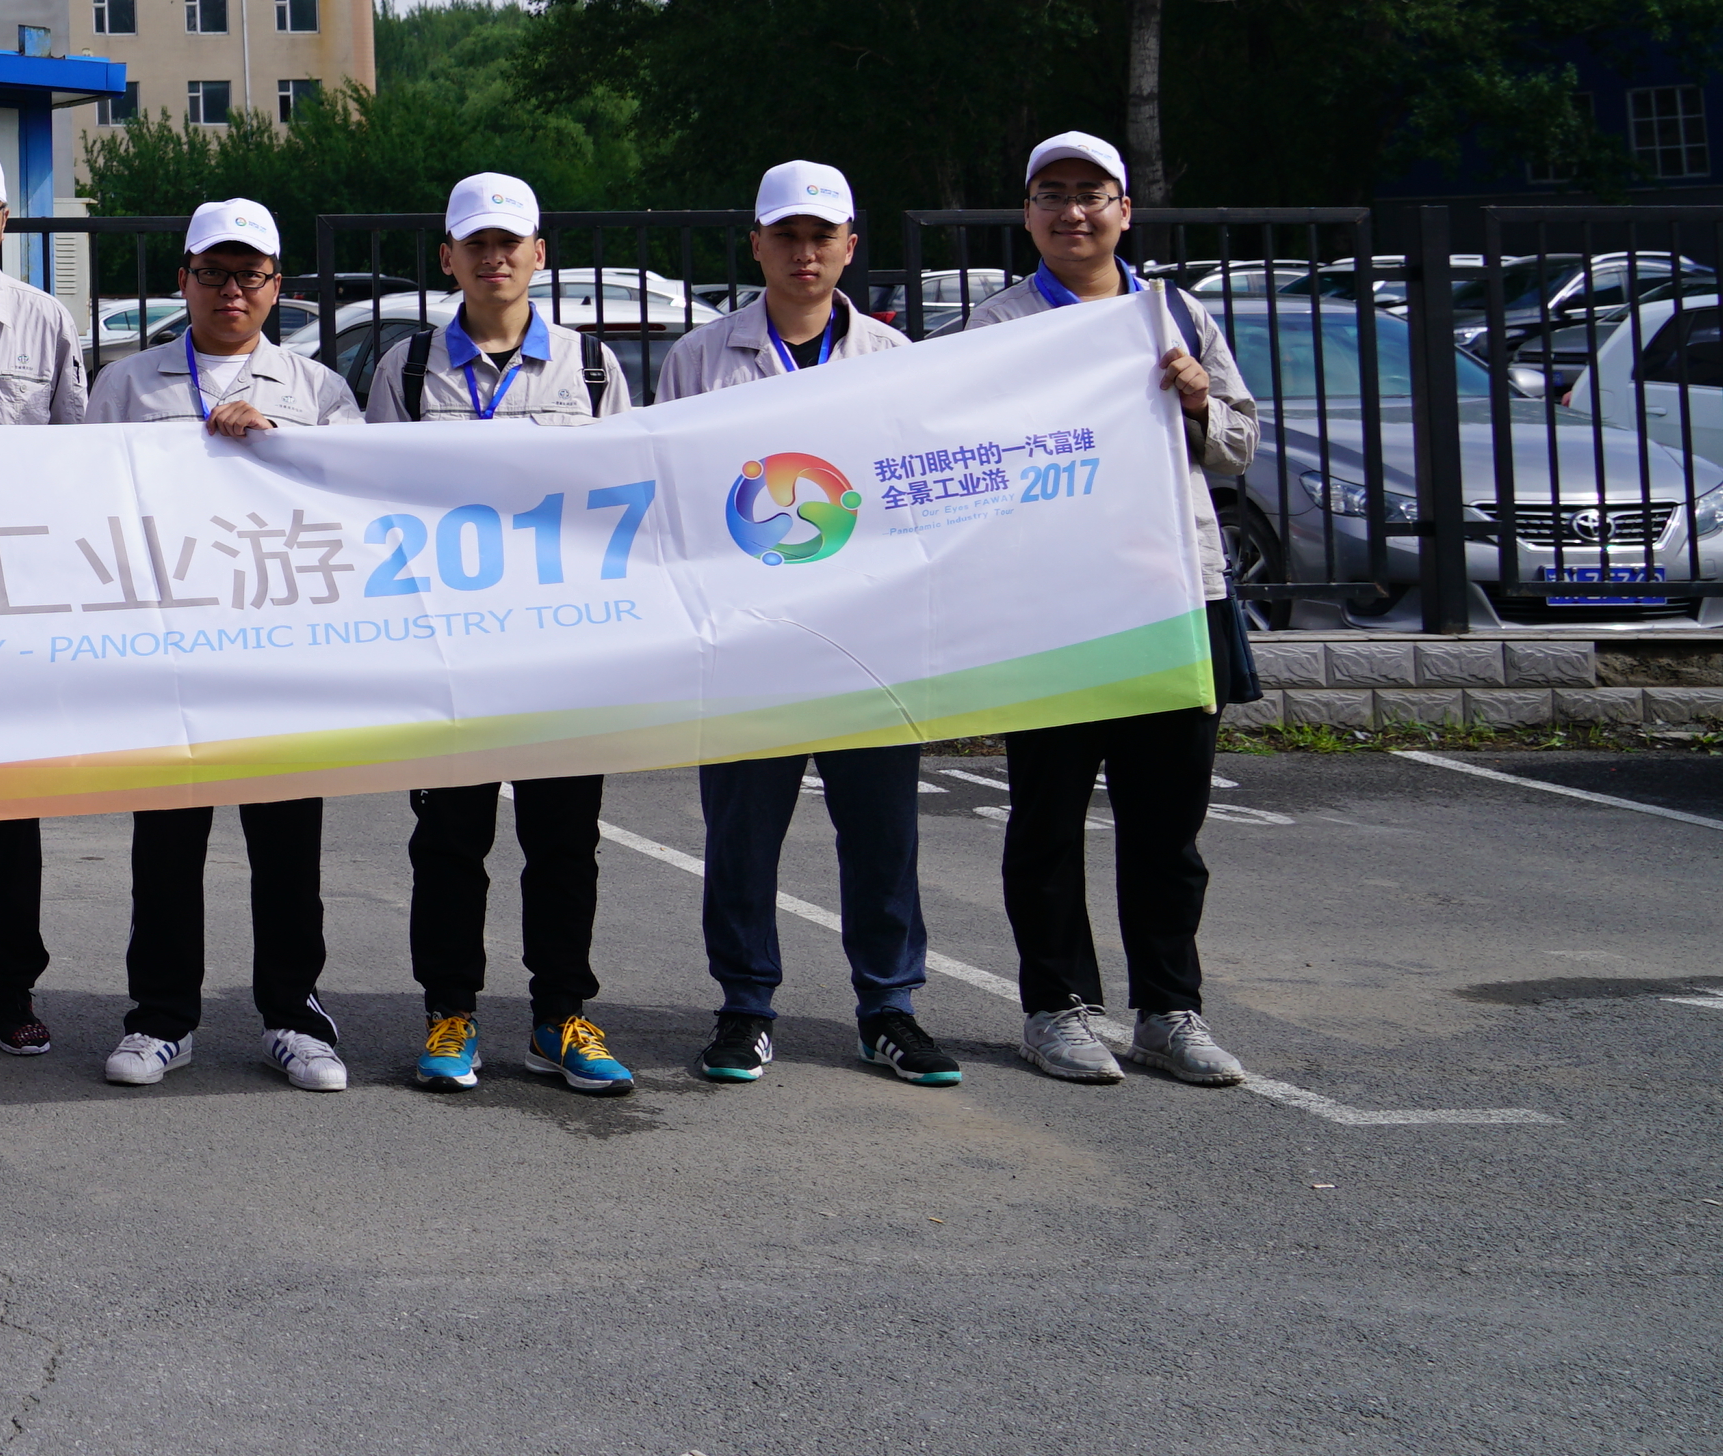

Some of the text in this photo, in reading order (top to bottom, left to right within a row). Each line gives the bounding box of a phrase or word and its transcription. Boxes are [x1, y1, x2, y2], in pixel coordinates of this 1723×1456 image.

[873, 428, 1096, 483] 我们眼中的一汽富维
[881, 457, 1100, 510] 全景工业游 2017
[921, 508, 940, 518] Our
[974, 493, 1015, 508] FAWAY
[946, 511, 989, 527] Industry
[994, 507, 1015, 517] Tour
[48, 624, 295, 664] PANORAMIC
[305, 608, 515, 647] INDUSTRY
[523, 599, 644, 630] TOUR
